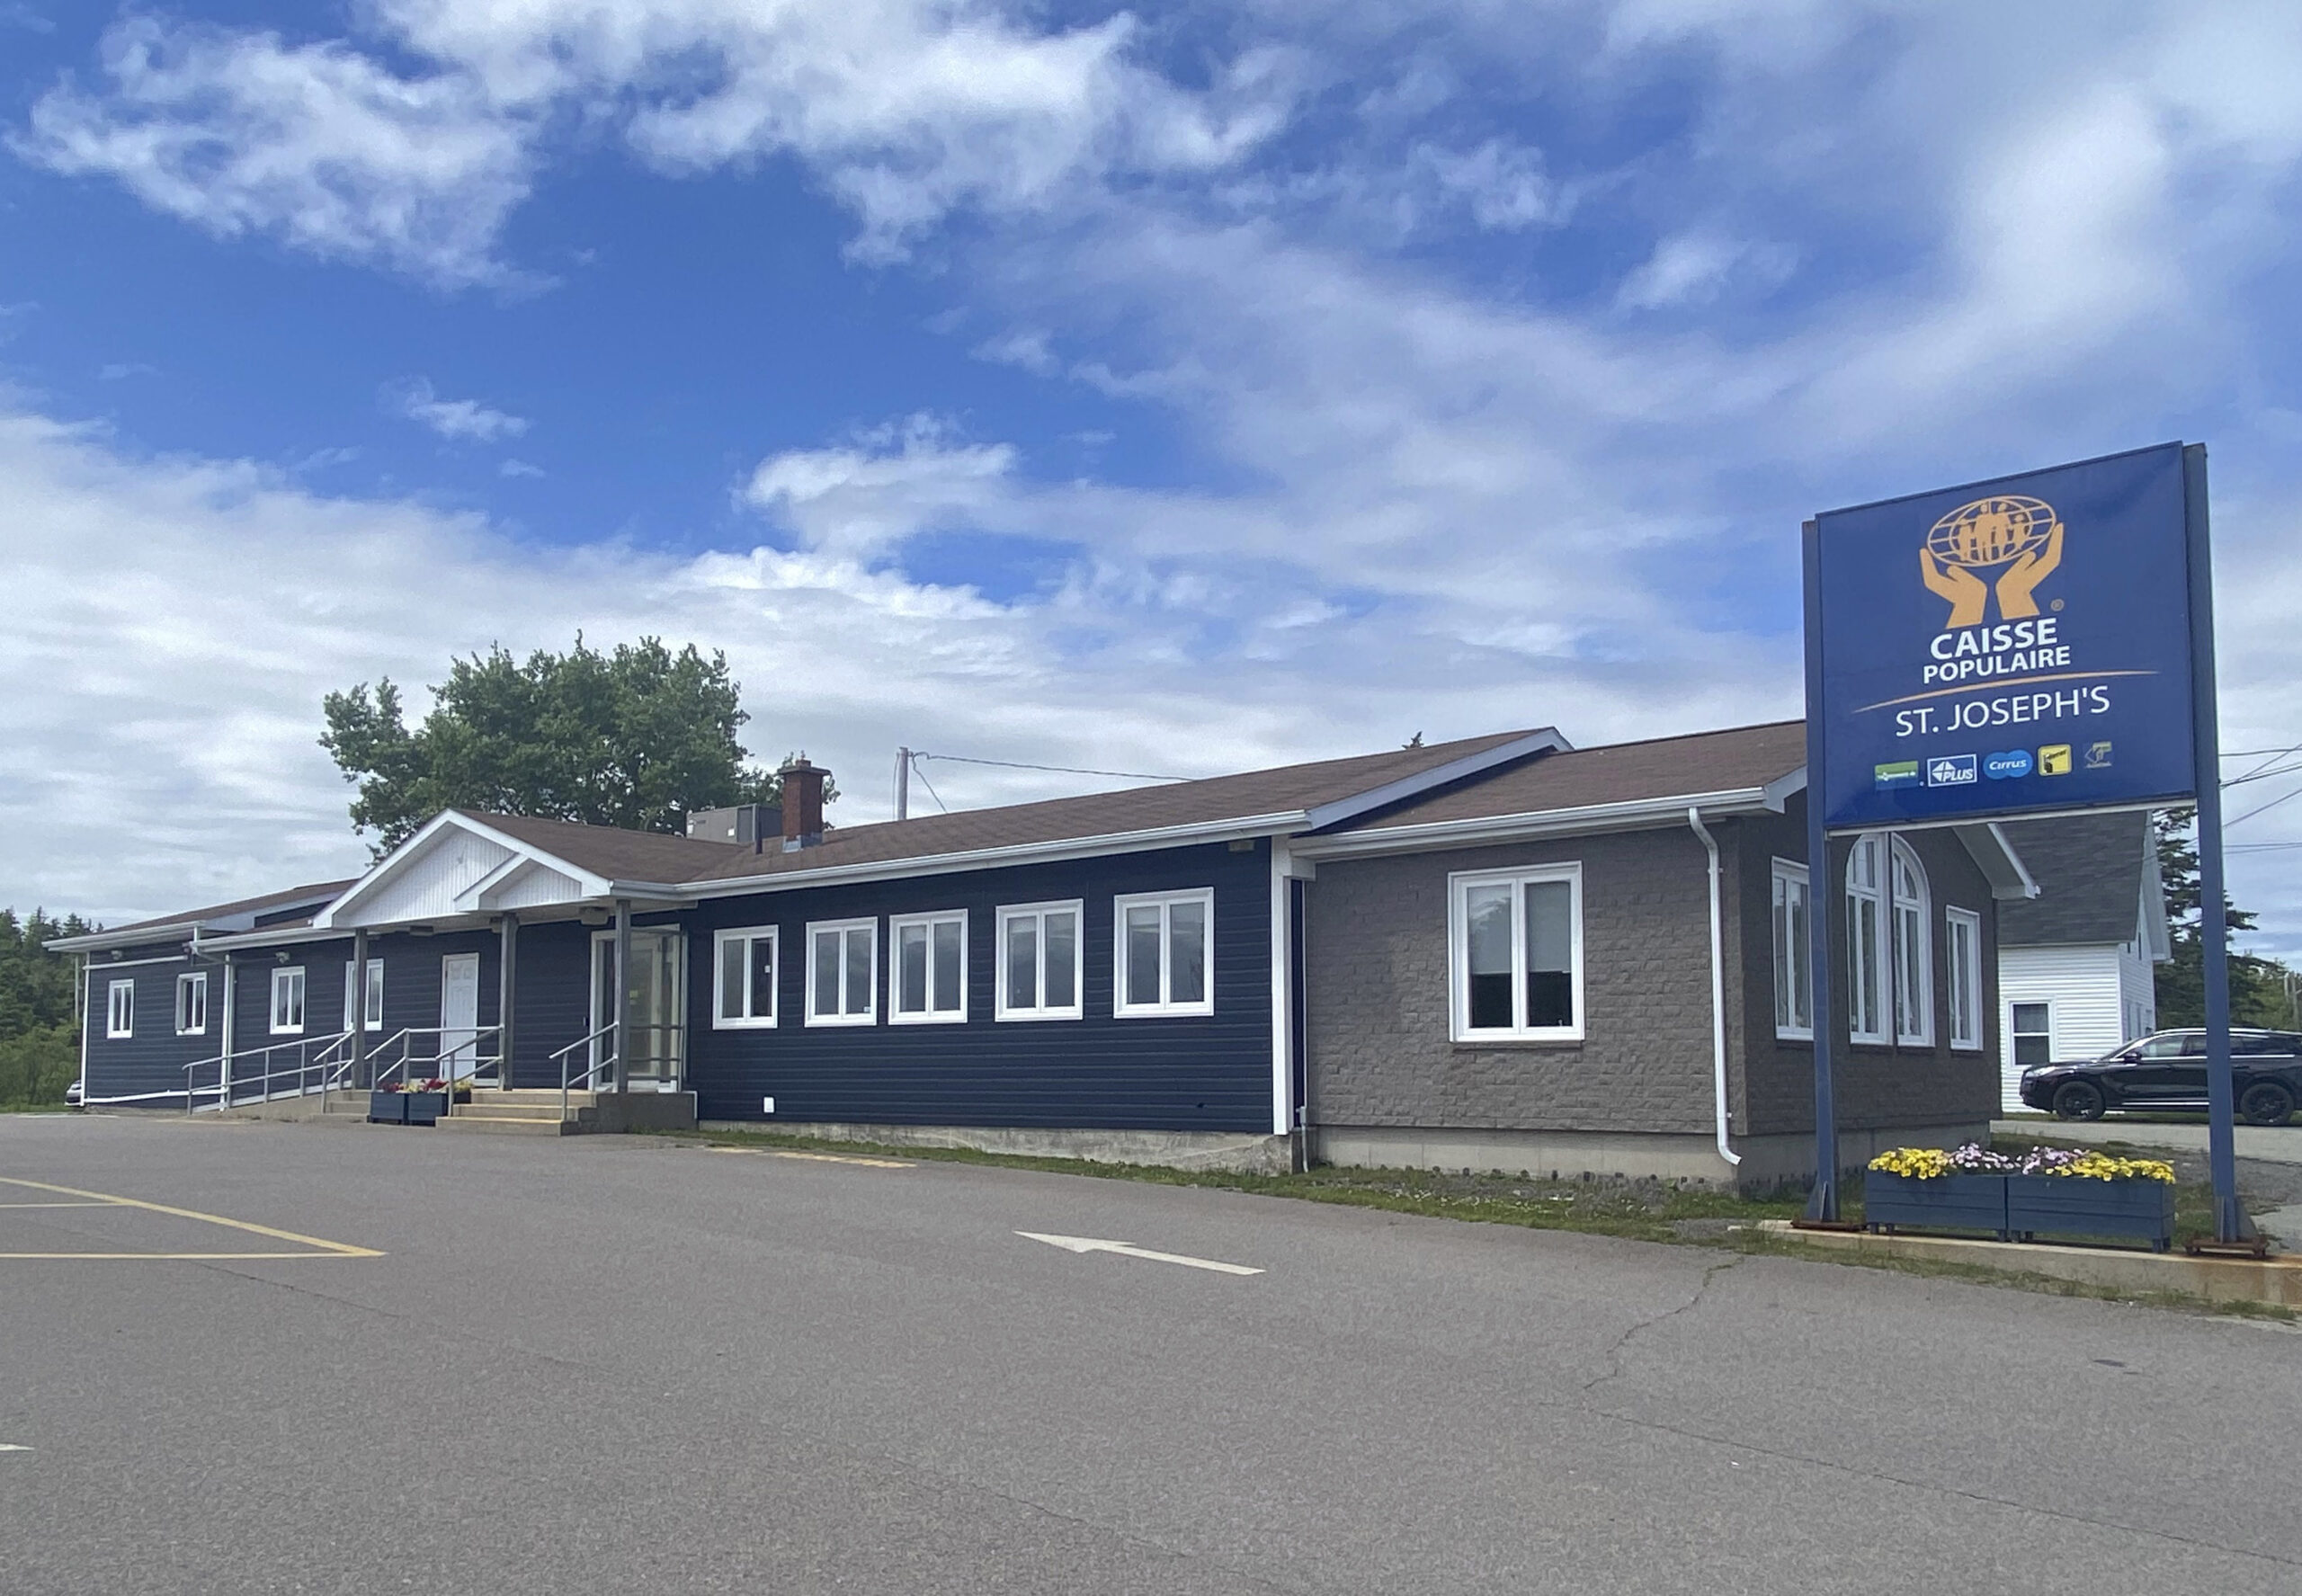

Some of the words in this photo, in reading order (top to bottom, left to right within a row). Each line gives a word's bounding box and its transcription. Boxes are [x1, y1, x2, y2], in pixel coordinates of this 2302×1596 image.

[1930, 617, 2057, 660] CAISSE
[1923, 646, 2071, 684] POPULAIRE
[1896, 707, 1940, 737] ST.
[1947, 685, 2111, 732] JOSEPH'S
[1941, 768, 1974, 782] PLUS
[1988, 759, 2027, 771] Cirrus
